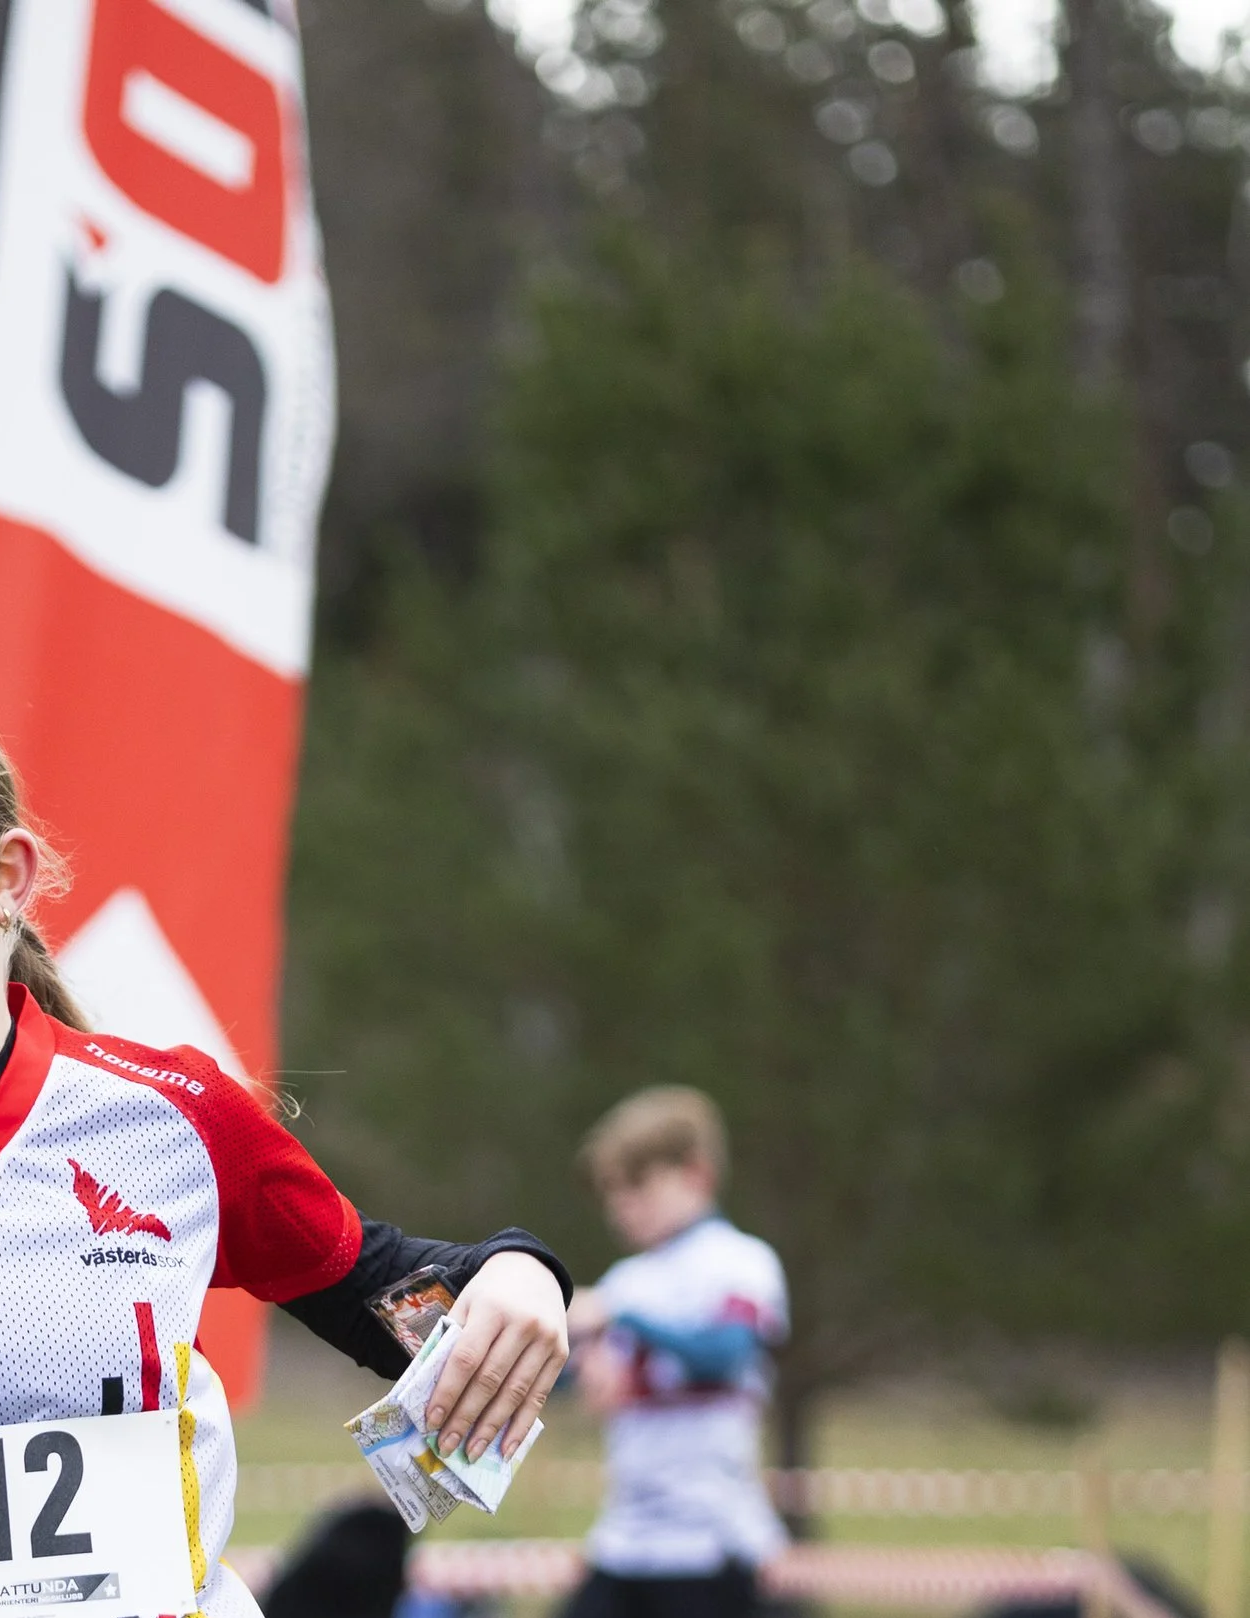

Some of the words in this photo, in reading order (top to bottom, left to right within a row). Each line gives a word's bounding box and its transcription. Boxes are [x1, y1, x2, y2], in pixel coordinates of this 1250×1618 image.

[59, 0, 295, 549] SO
[84, 1042, 205, 1096] noname
[0, 1579, 78, 1597] ATTUNDA
